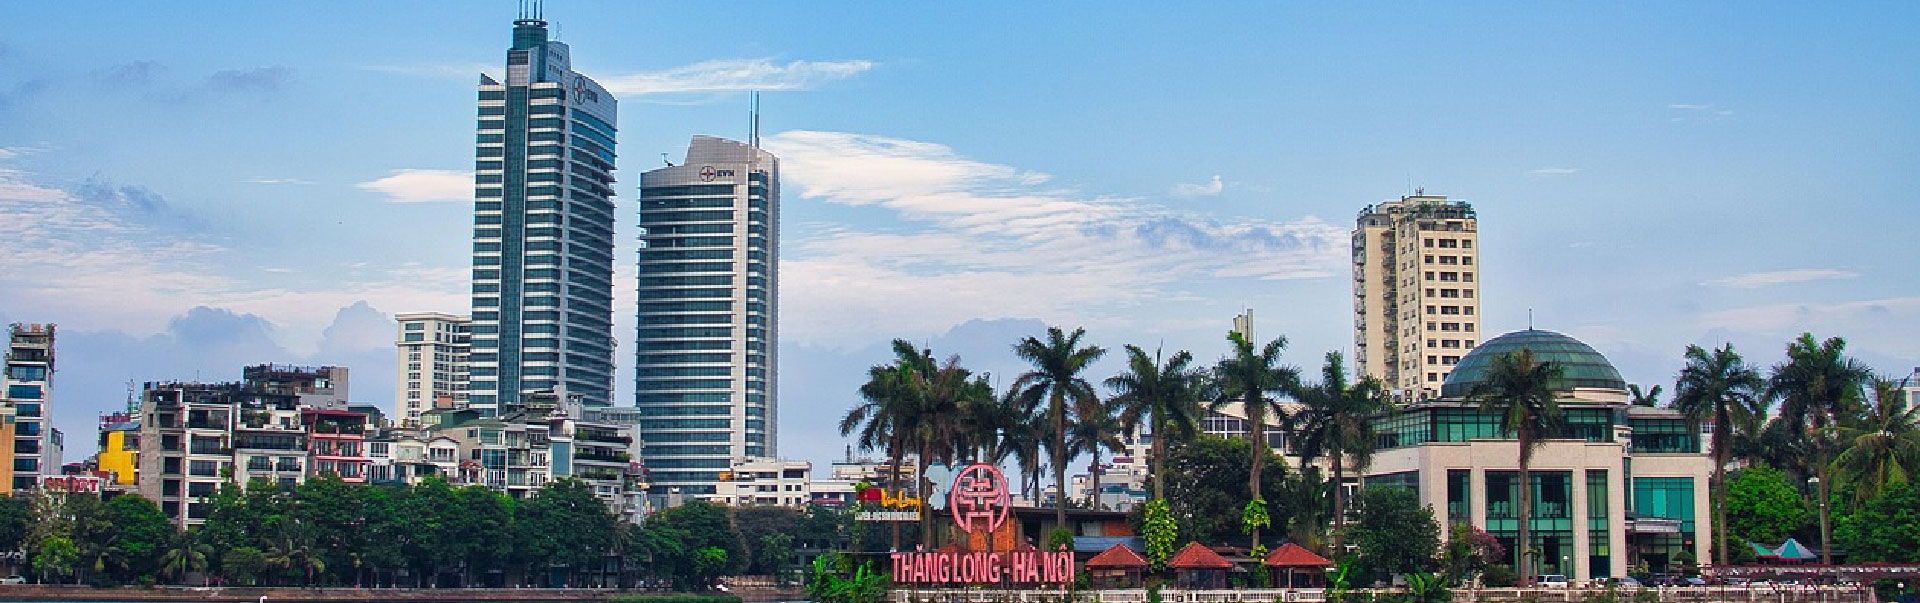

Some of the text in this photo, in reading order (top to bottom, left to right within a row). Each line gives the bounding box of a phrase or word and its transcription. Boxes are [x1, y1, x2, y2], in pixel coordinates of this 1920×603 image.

[716, 169, 735, 177] EVN
[890, 544, 950, 583] THĂNG
[952, 552, 1001, 583] LONG
[1013, 545, 1039, 583] HÀ
